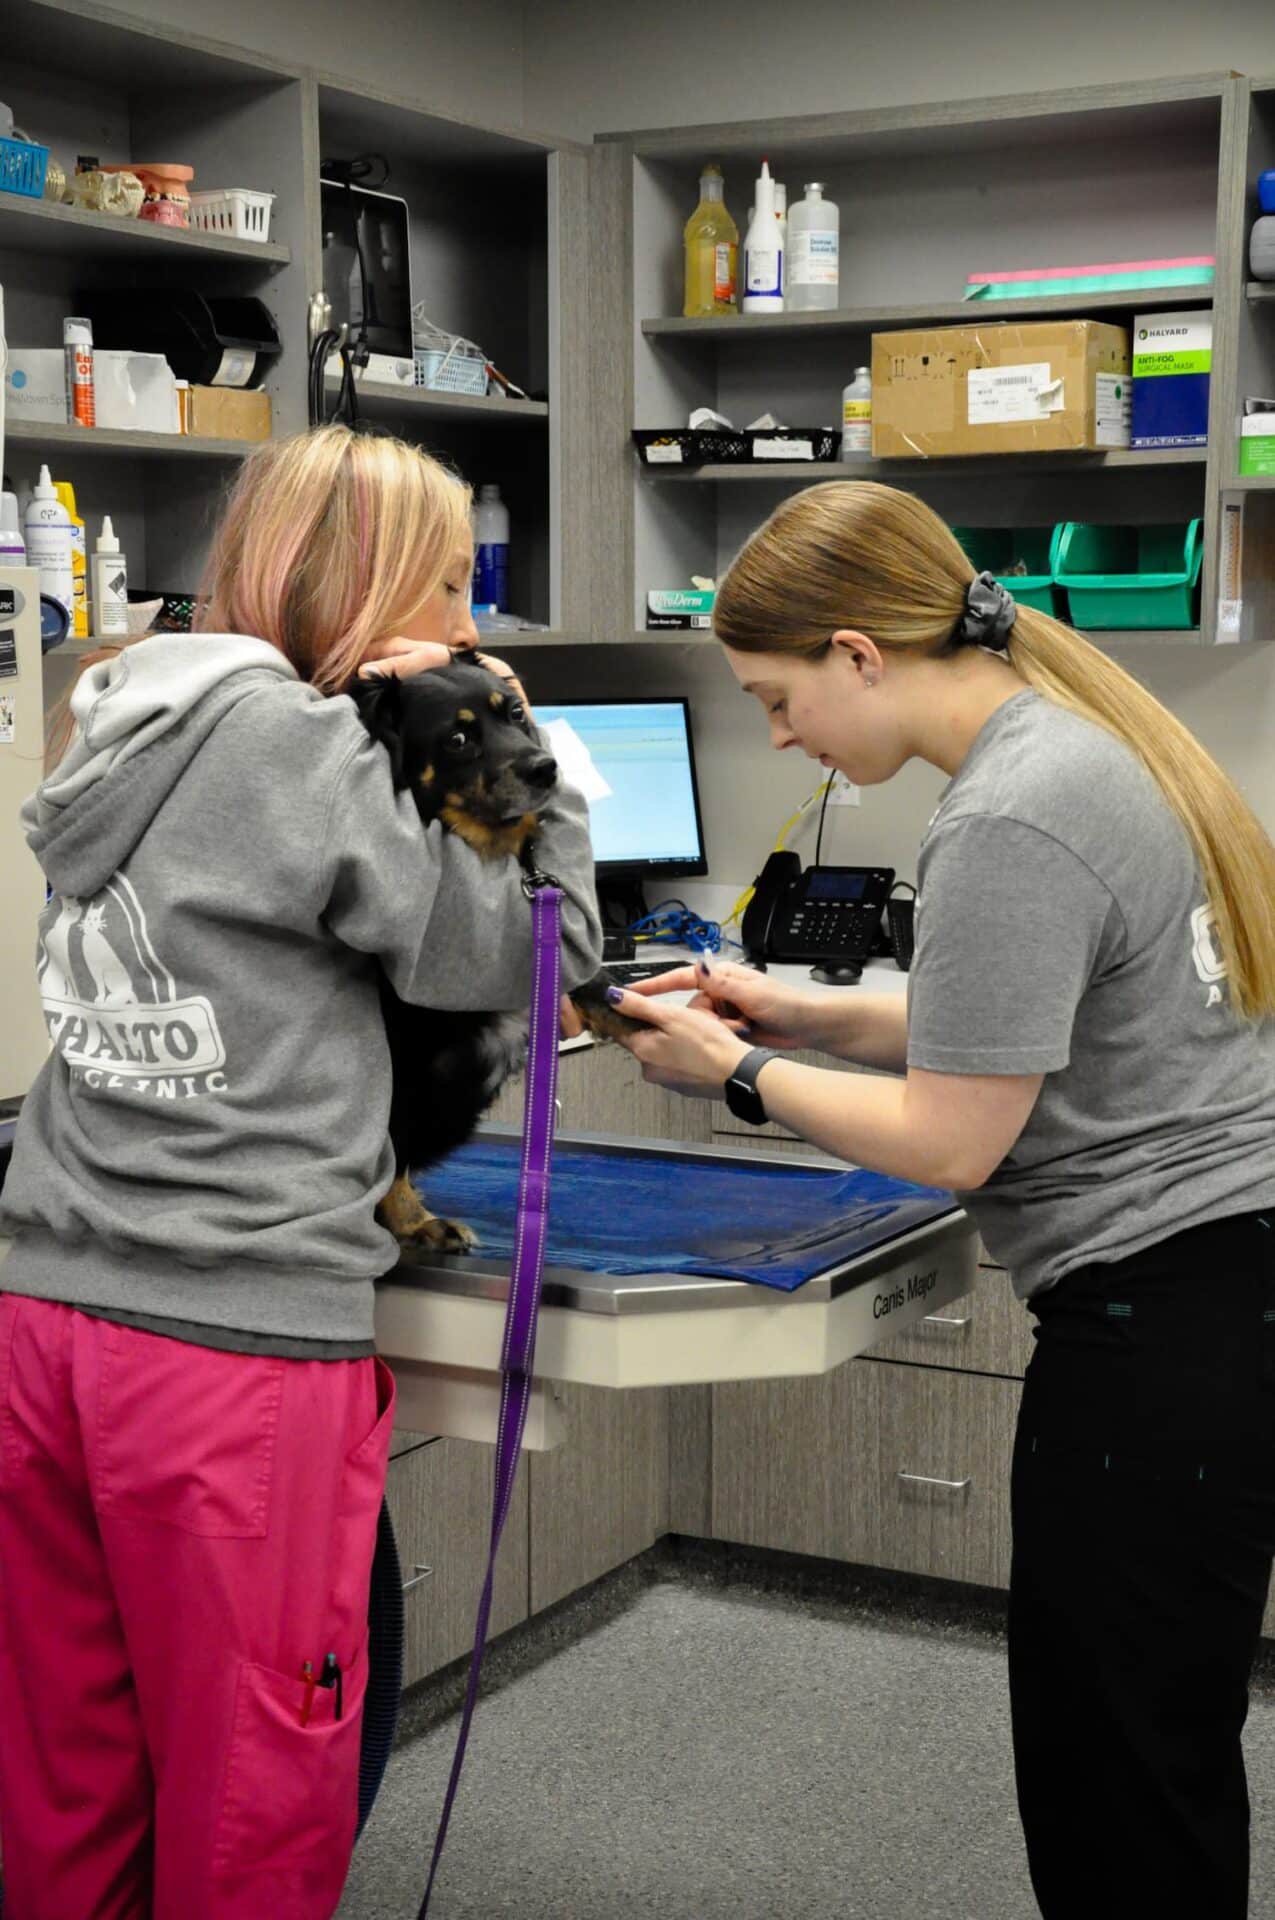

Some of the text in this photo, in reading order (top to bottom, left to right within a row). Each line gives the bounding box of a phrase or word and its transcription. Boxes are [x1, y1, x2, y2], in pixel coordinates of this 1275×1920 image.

[1149, 327, 1188, 337] HALYARD
[1137, 355, 1175, 365] ANTI-FOG
[1138, 362, 1194, 372] SURGICAL MASK
[873, 1273, 937, 1319] Canis Major
